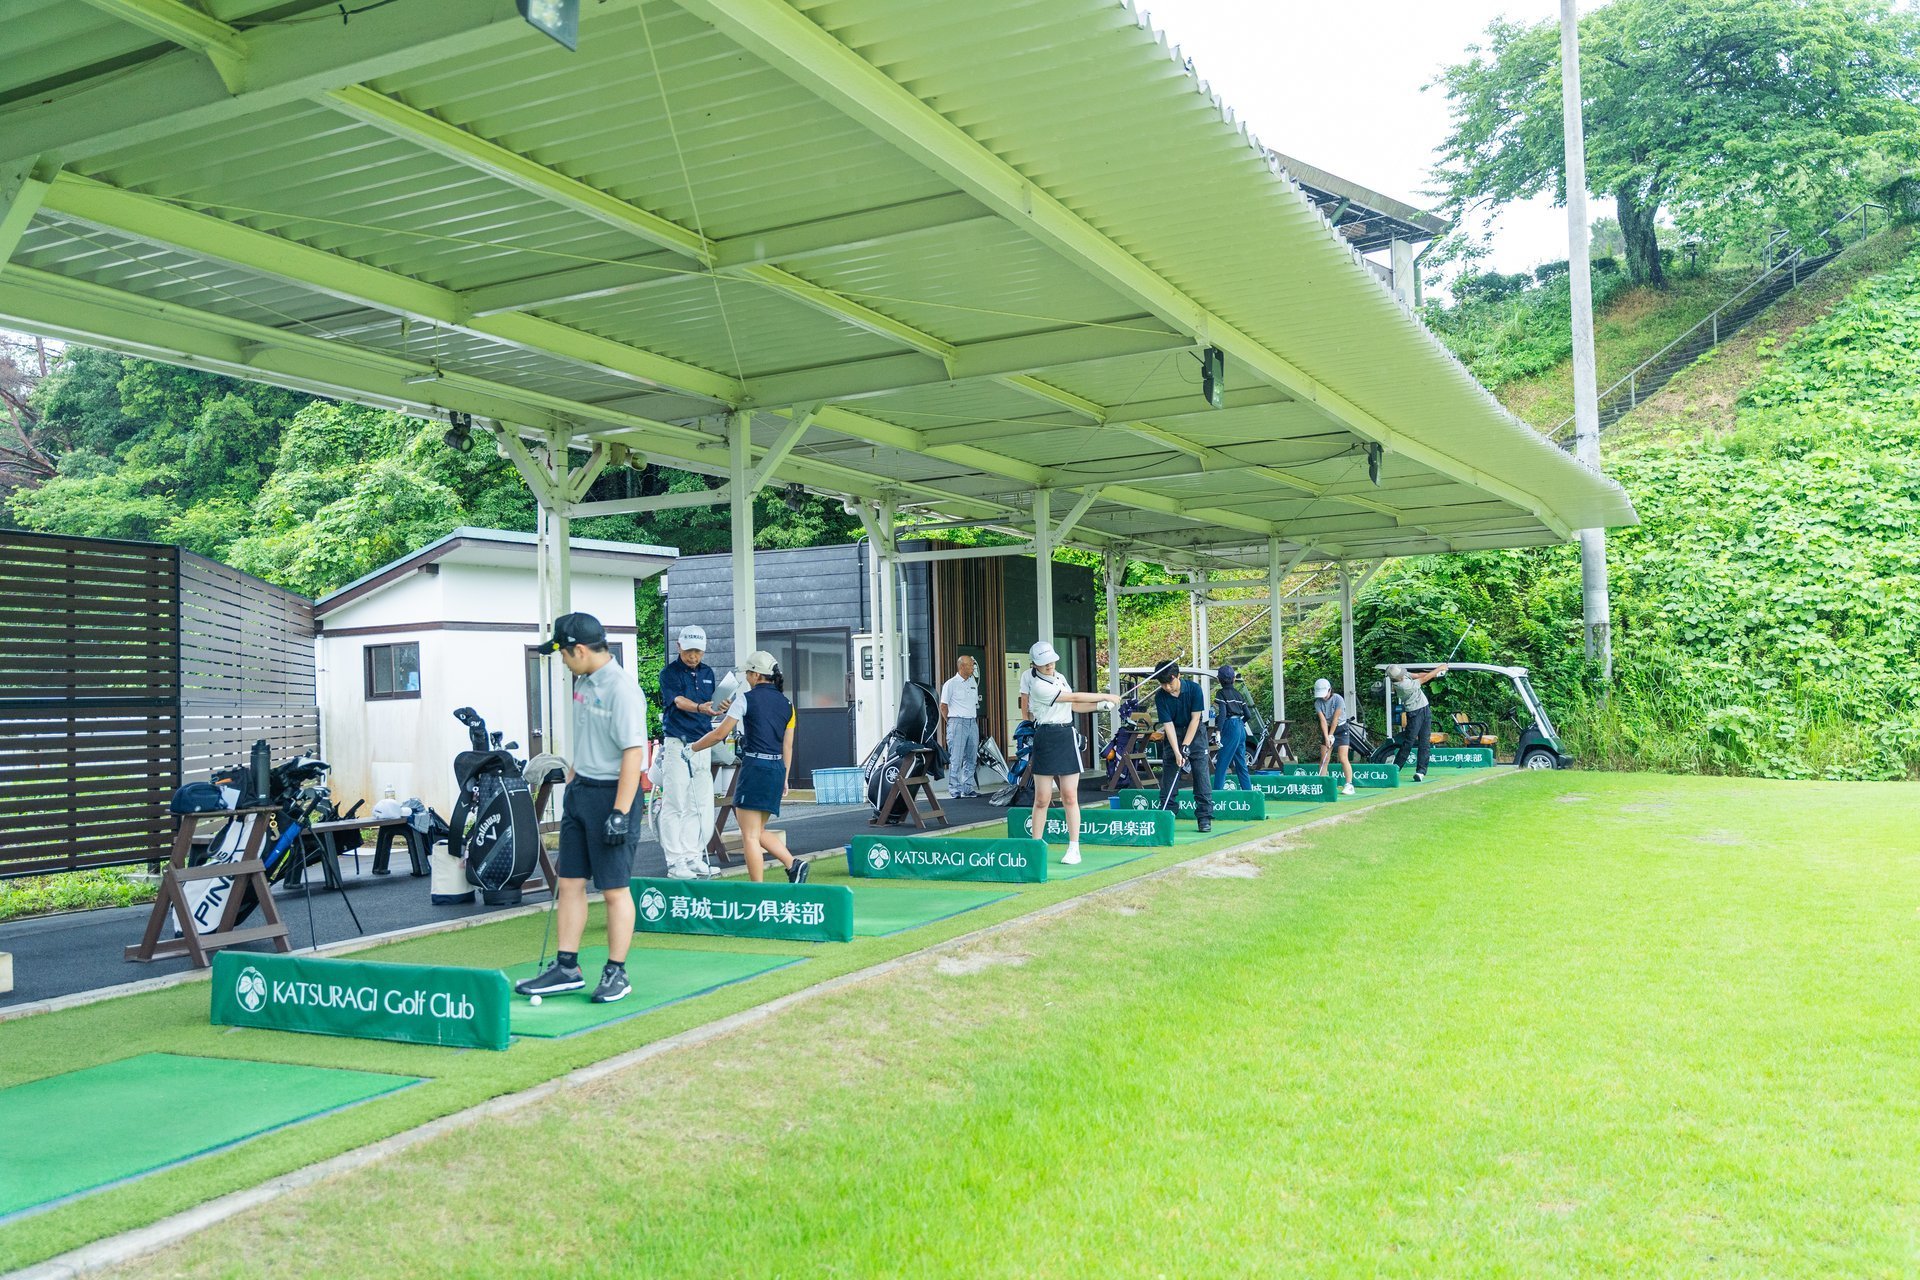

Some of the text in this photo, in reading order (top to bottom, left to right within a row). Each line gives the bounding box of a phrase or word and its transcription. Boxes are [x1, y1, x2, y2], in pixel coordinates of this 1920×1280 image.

[1429, 753, 1483, 763] 城ゴルフ倶楽部
[1370, 771, 1388, 780] Club
[1239, 783, 1323, 795] 城ゴルフ倶楽部
[1228, 800, 1251, 811] Club
[475, 812, 502, 847] Callaway
[894, 850, 1027, 868] KATSURAGI Golf Club
[668, 895, 825, 925] 葛城ゴルフ倶楽部
[273, 980, 475, 1020] KATSURAGI Golf Club
